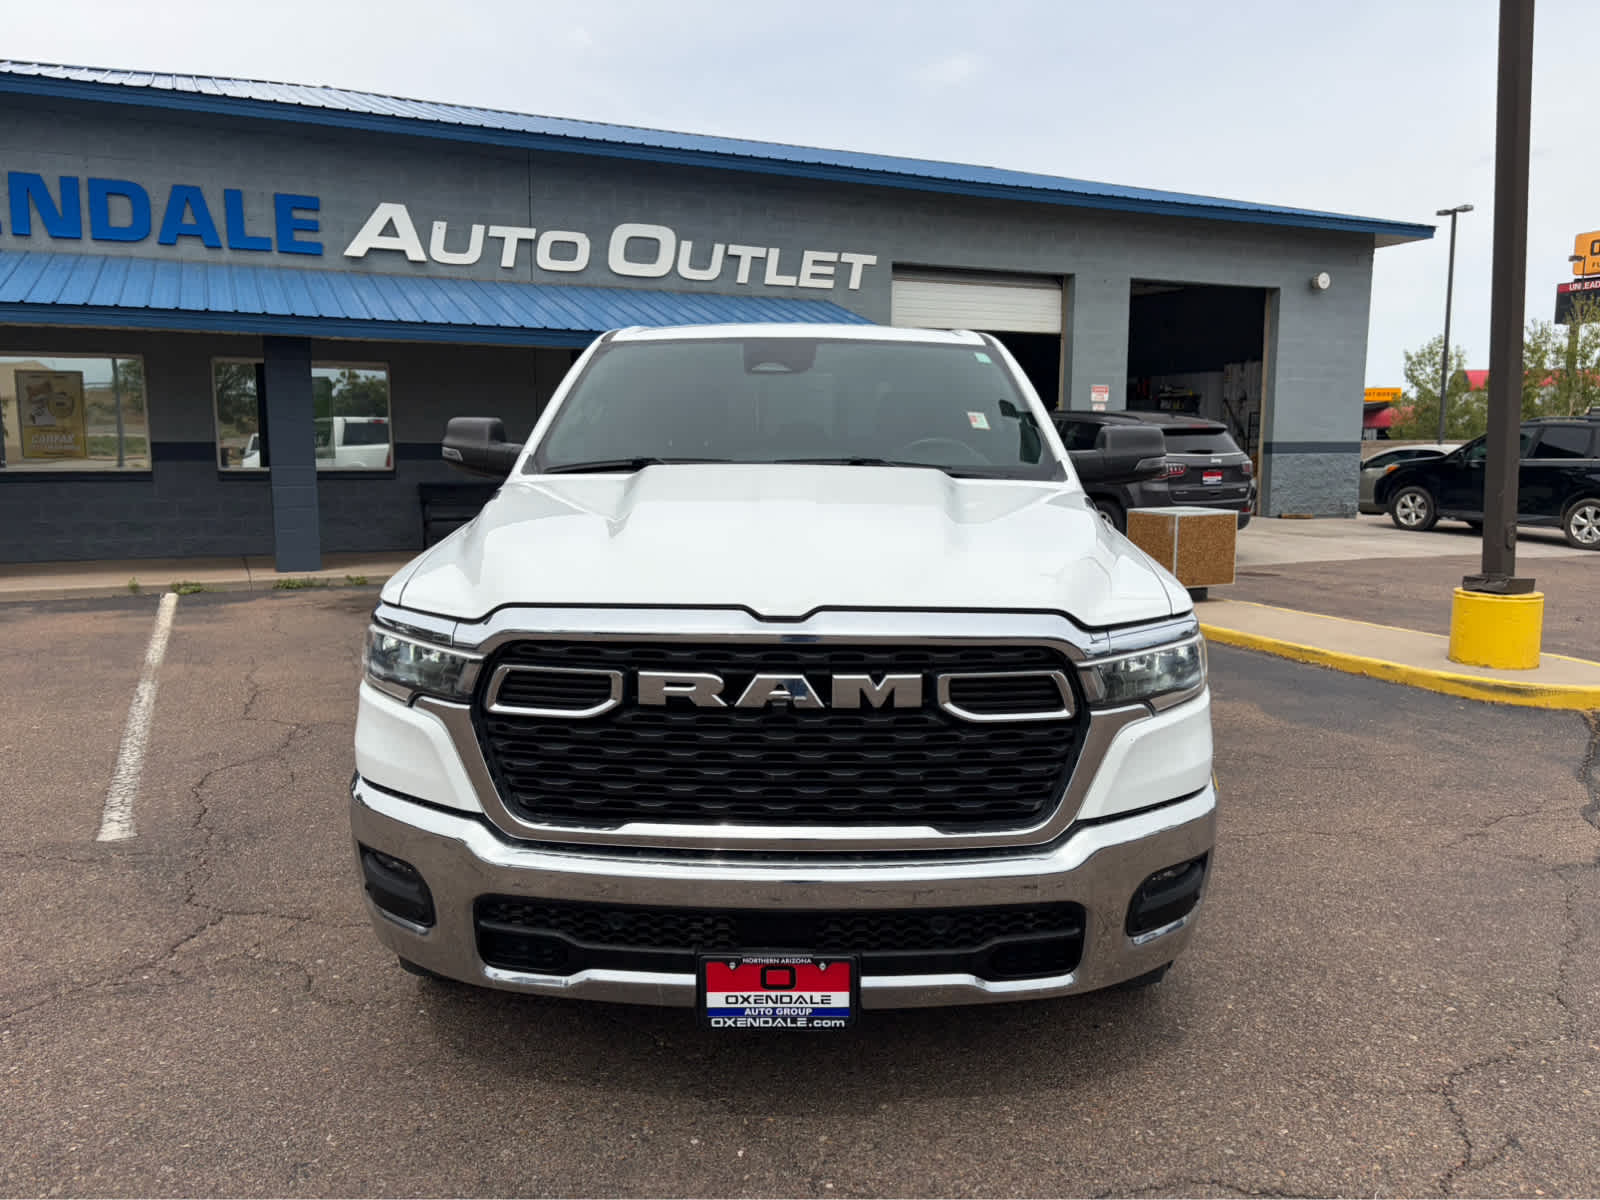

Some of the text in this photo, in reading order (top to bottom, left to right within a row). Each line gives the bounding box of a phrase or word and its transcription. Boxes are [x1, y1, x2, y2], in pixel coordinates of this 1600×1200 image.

[0, 171, 323, 256] NDALE
[607, 223, 877, 290] OUTLET
[638, 671, 922, 709] RAM
[725, 995, 832, 1005] OXENDALE
[744, 1008, 813, 1016] AUTO GROUP
[711, 1018, 846, 1028] OXENDALE.com
